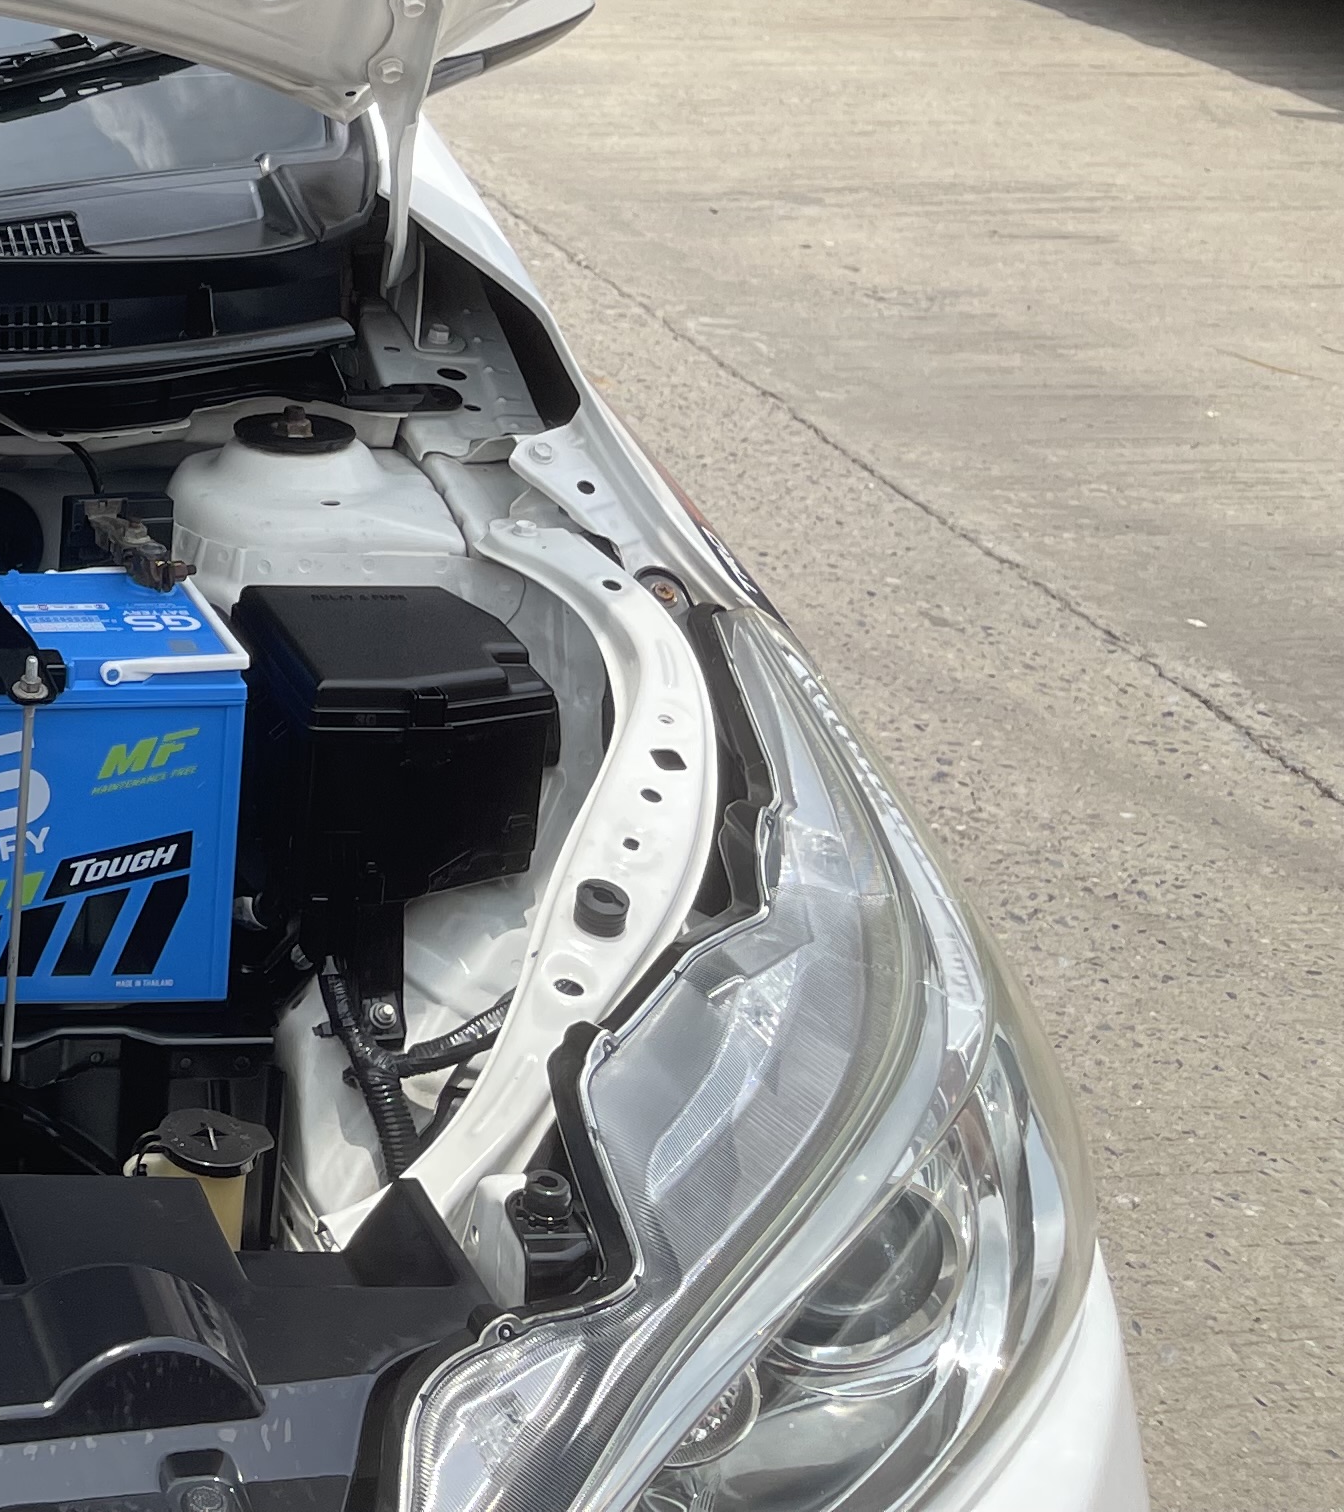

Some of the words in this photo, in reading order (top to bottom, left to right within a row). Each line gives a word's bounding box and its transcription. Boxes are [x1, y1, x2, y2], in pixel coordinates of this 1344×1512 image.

[123, 615, 202, 632] GS
[97, 727, 200, 780] MF
[68, 843, 179, 887] TOUGH
